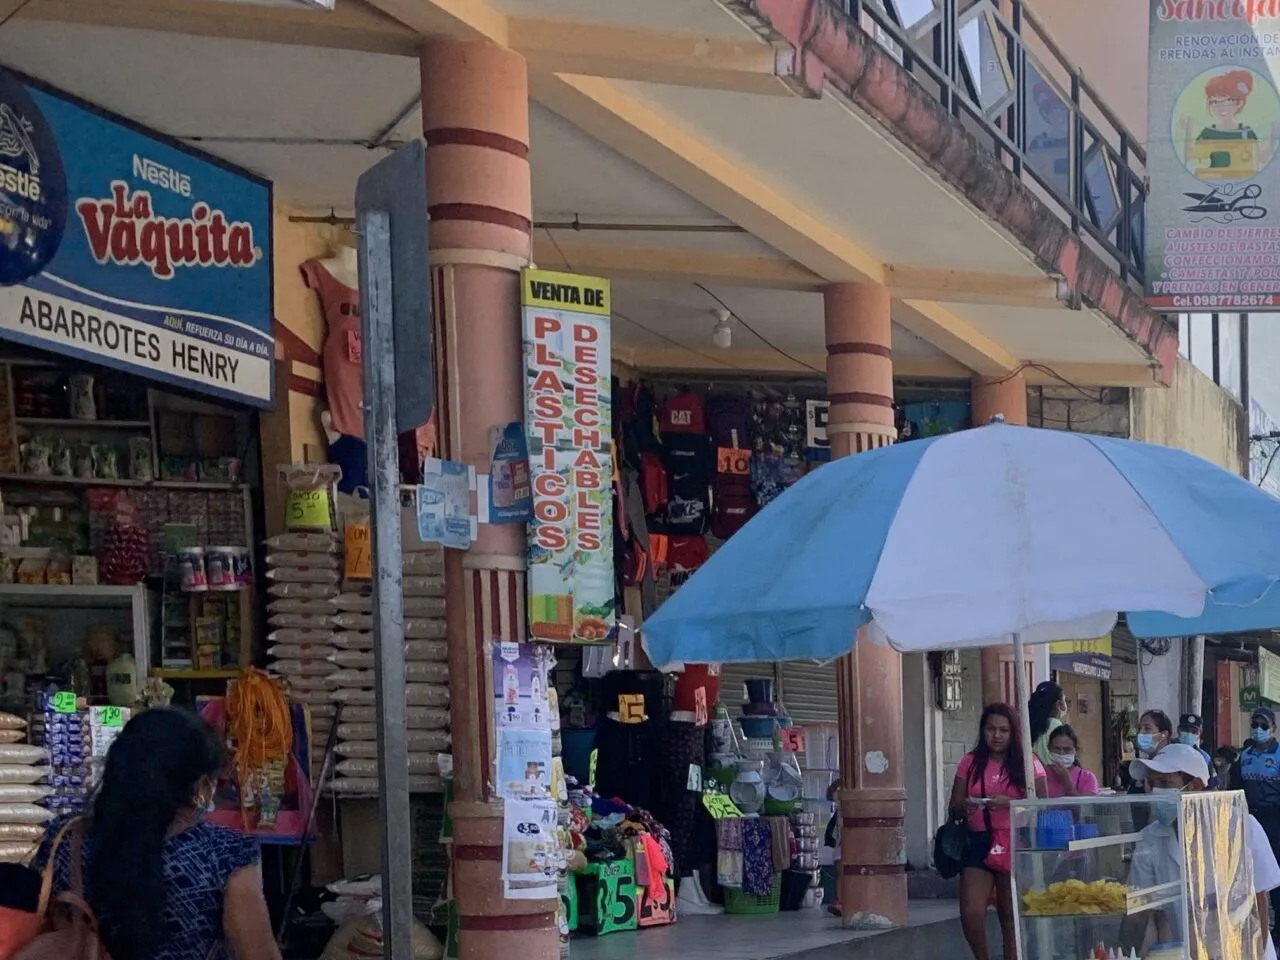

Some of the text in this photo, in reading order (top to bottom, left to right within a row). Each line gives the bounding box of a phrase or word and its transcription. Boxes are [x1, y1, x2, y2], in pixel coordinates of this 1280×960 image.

[1175, 33, 1280, 47] RENOVACIÓN DE
[1160, 48, 1217, 60] PRENDAS
[1220, 48, 1237, 58] AL
[113, 184, 149, 219] La
[78, 202, 253, 276] Vaquita
[1166, 229, 1214, 239] CAMBIO
[1217, 229, 1233, 238] DE
[1166, 242, 1217, 253] AJUSTES
[1219, 242, 1236, 251] DE
[1170, 268, 1236, 280] CAMISETAS
[530, 280, 604, 307] VENTA DE
[1153, 281, 1162, 294] Y
[1163, 281, 1218, 294] PRENDAS
[1220, 281, 1238, 292] EN
[1194, 295, 1274, 307] 0987782674
[20, 294, 161, 362] ABARROTES
[185, 321, 223, 344] REFUERZA
[224, 333, 235, 346] SU
[235, 335, 248, 350] DÍA
[172, 339, 239, 384] HENRY
[671, 410, 692, 425] CAT
[532, 316, 568, 550] PLASTICOS
[573, 324, 600, 551] DESECHABLES
[723, 454, 748, 473] 10
